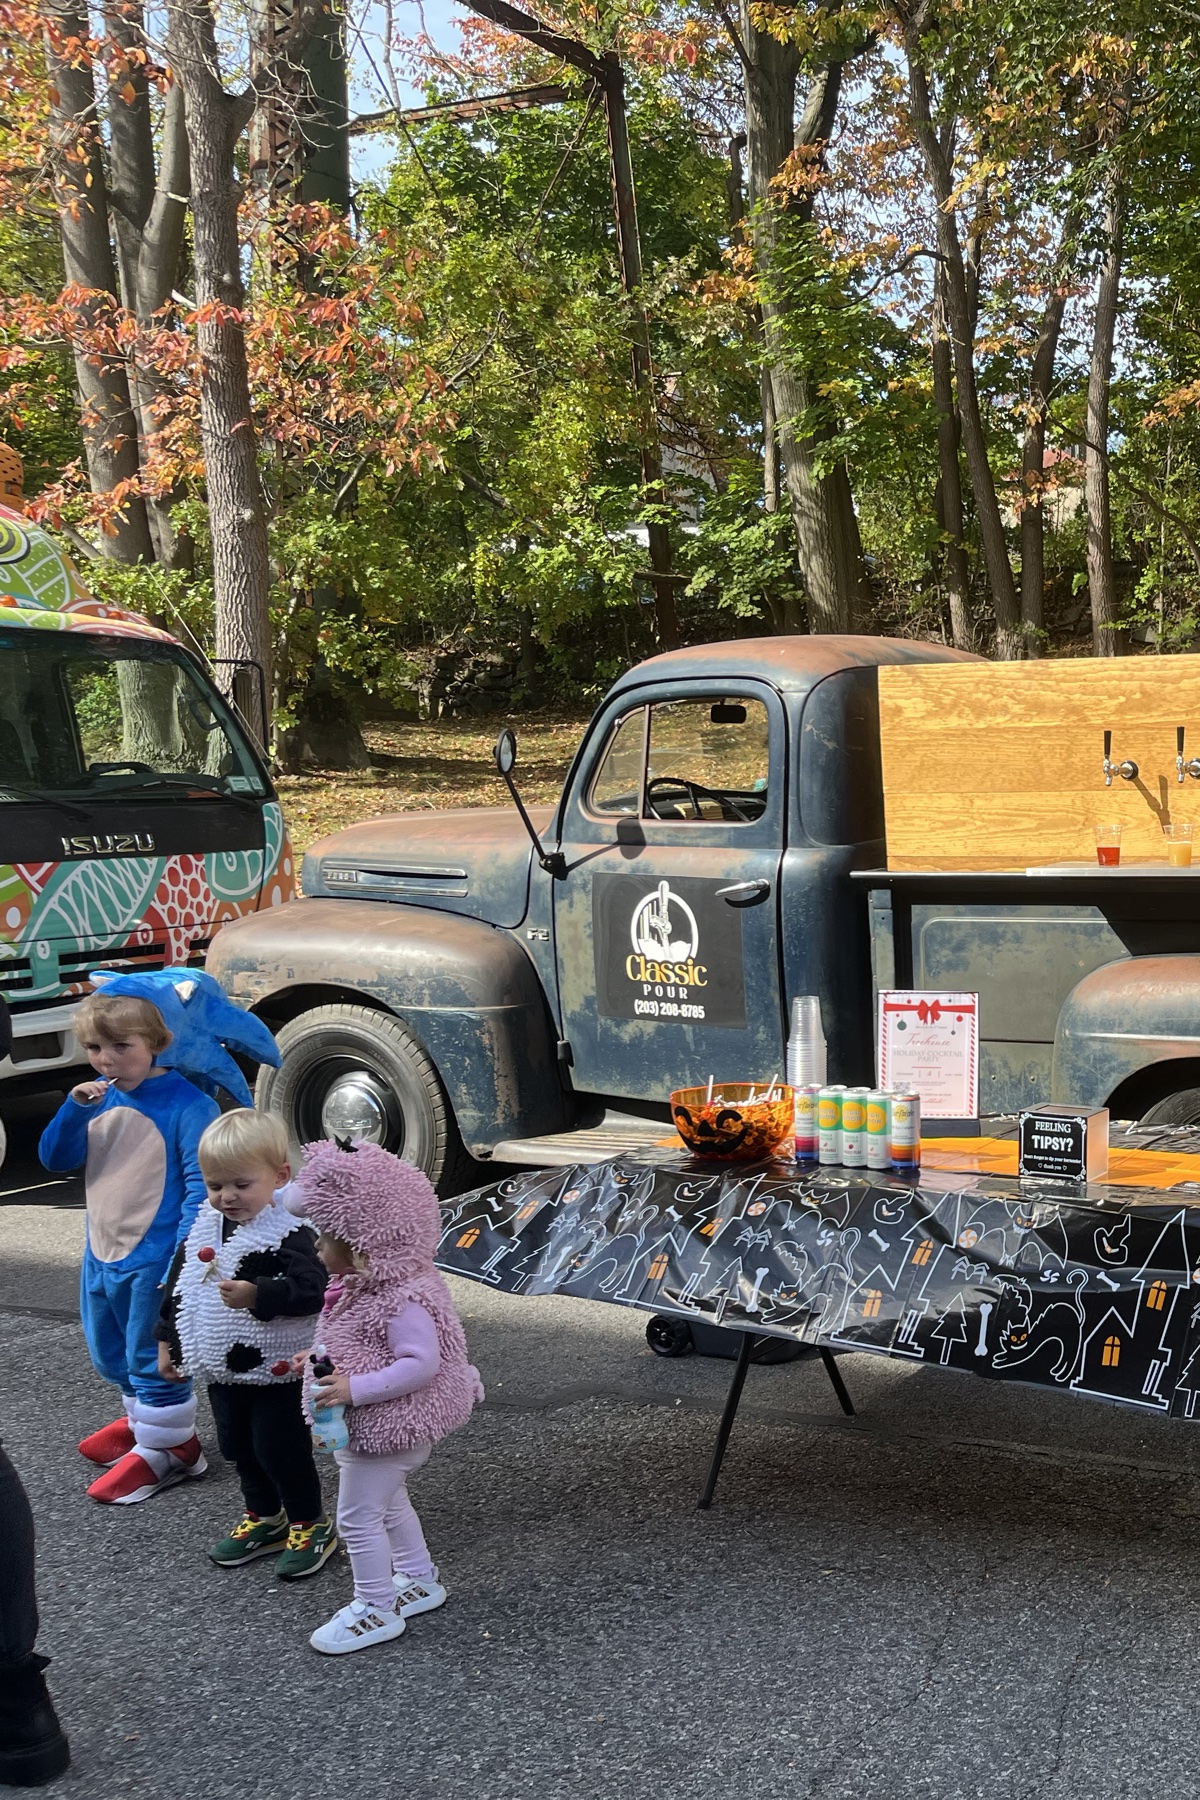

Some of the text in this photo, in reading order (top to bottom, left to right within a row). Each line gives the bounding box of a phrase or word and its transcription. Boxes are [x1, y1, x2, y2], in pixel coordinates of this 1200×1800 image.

[61, 833, 156, 856] ISUZU
[625, 954, 708, 987] Classic
[643, 984, 688, 999] POUR
[634, 999, 659, 1016] (203)
[906, 1032, 950, 1046] Treehouse
[1034, 1120, 1071, 1133] FEELING
[1031, 1134, 1074, 1152] TIPSY?
